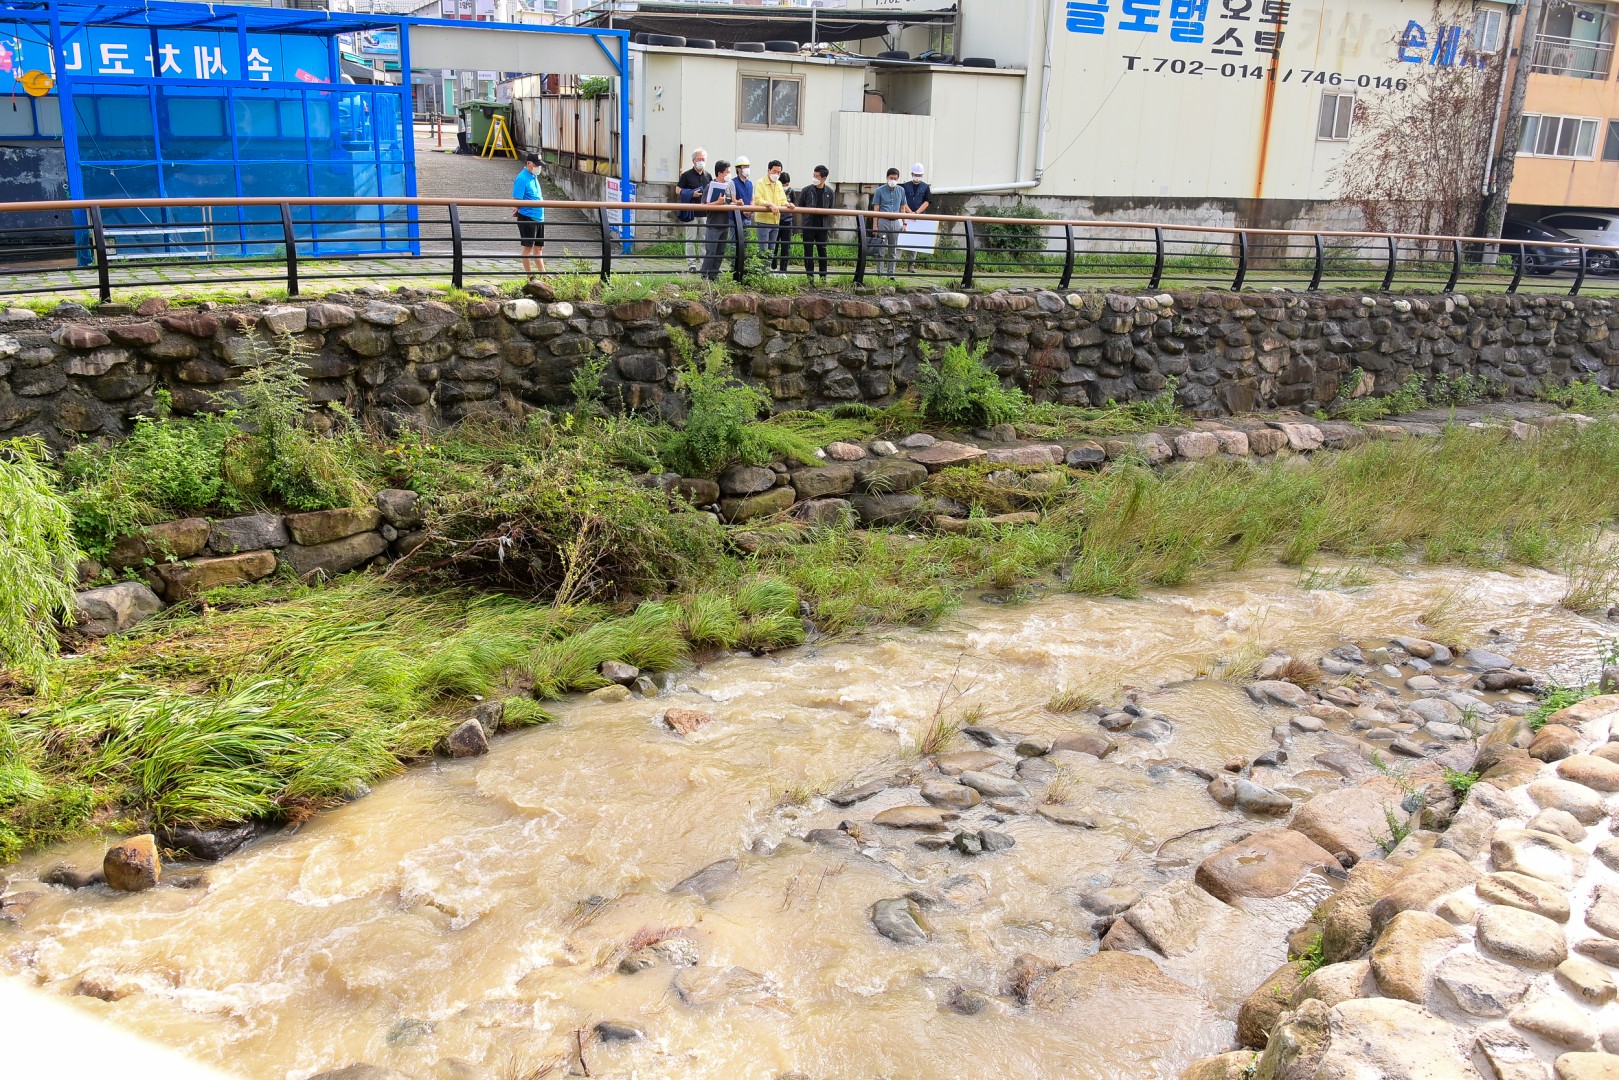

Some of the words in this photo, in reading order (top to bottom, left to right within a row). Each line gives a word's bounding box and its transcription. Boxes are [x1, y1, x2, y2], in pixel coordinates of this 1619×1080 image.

[1066, 0, 1209, 44] 글로벌
[1220, 0, 1291, 25] 오토
[1211, 27, 1285, 59] 스틱
